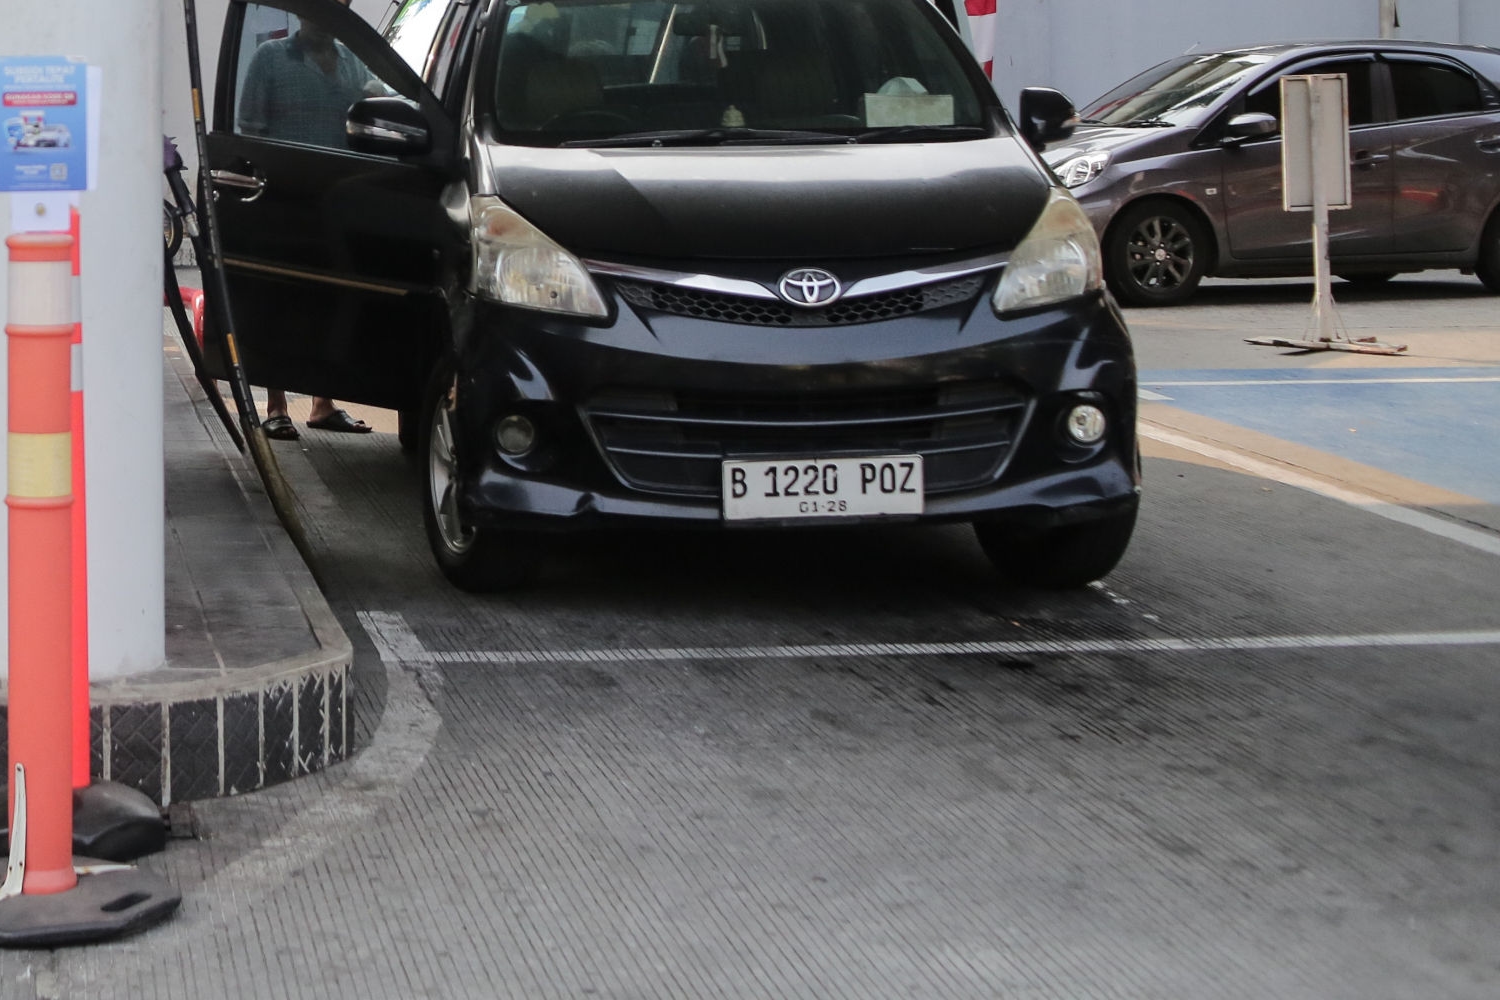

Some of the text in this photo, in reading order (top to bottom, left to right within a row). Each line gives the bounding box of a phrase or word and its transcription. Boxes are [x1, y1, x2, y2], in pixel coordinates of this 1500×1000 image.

[731, 462, 916, 499] B 1220 POZ
